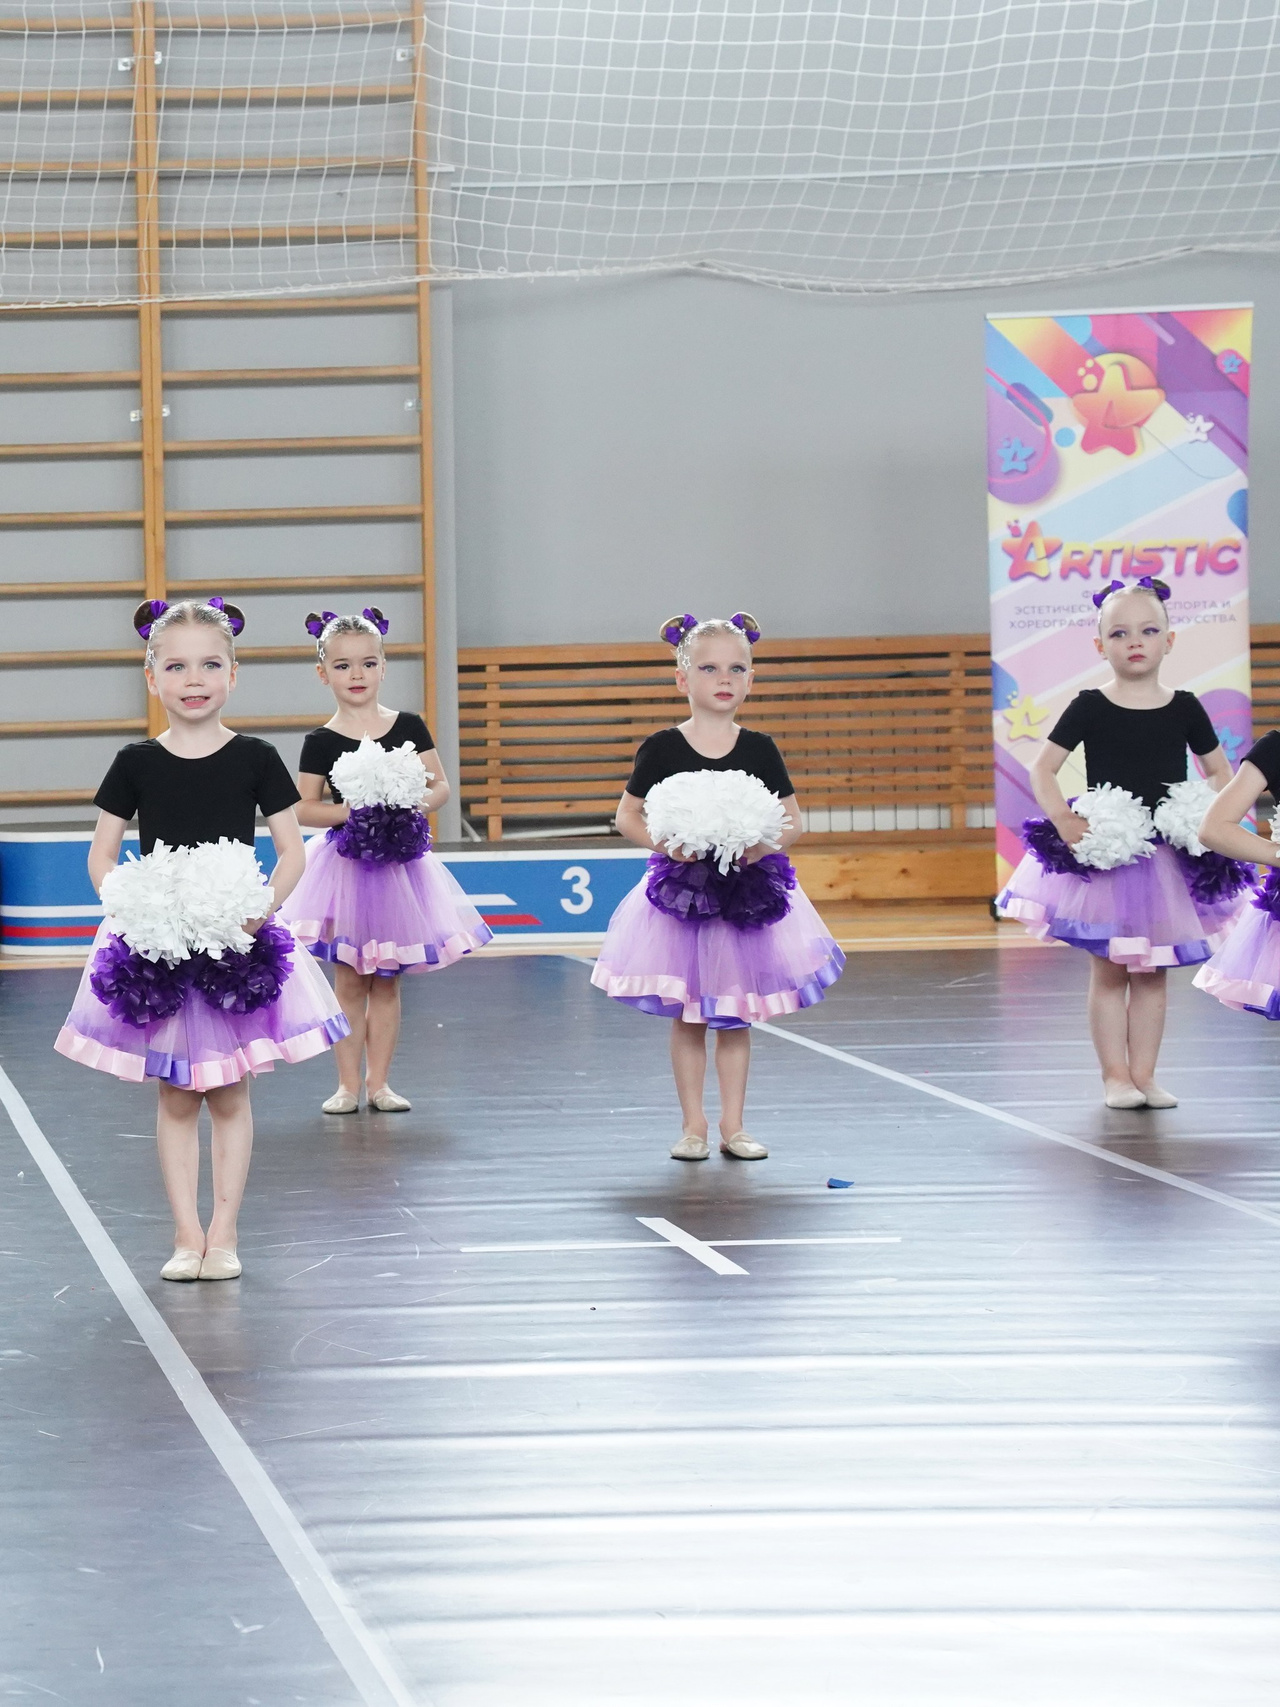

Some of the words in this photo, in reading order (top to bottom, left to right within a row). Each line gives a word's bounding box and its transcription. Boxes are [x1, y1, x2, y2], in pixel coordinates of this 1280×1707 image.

[1001, 520, 1242, 580] ARTISTIC
[1009, 618, 1096, 629] ХОРЕОГРАФИ
[1169, 613, 1237, 624] СКУССТВА
[1014, 603, 1098, 615] ЭСТЕТИЧЕСК
[560, 866, 593, 915] 3
